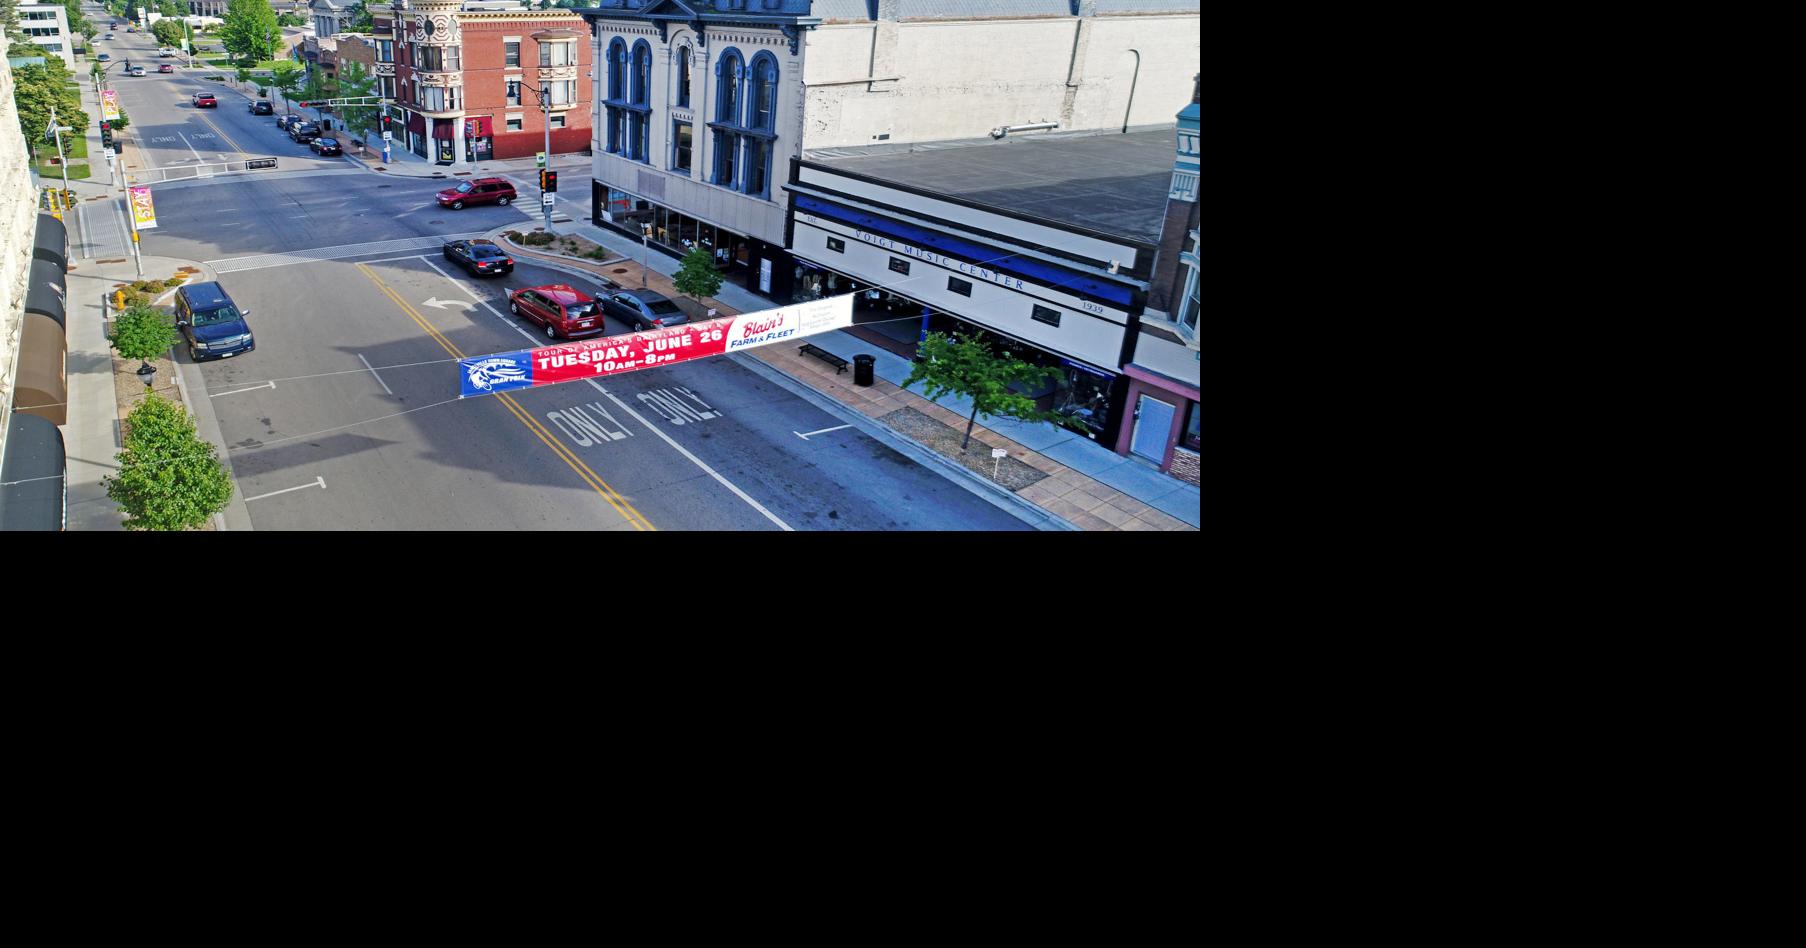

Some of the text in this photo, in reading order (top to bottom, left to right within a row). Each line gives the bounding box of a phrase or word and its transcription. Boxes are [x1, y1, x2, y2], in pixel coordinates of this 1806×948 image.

[855, 230, 1023, 290] VOIGT MUSIC CENTER
[1083, 301, 1104, 314] 1939
[730, 328, 796, 349] FARM & FLEET
[743, 312, 784, 339] Blair's
[537, 329, 723, 370] TUESDAY, JUNE 26
[537, 349, 563, 357] TOUR
[636, 385, 724, 426] ONLY
[546, 401, 635, 447] ONLY
